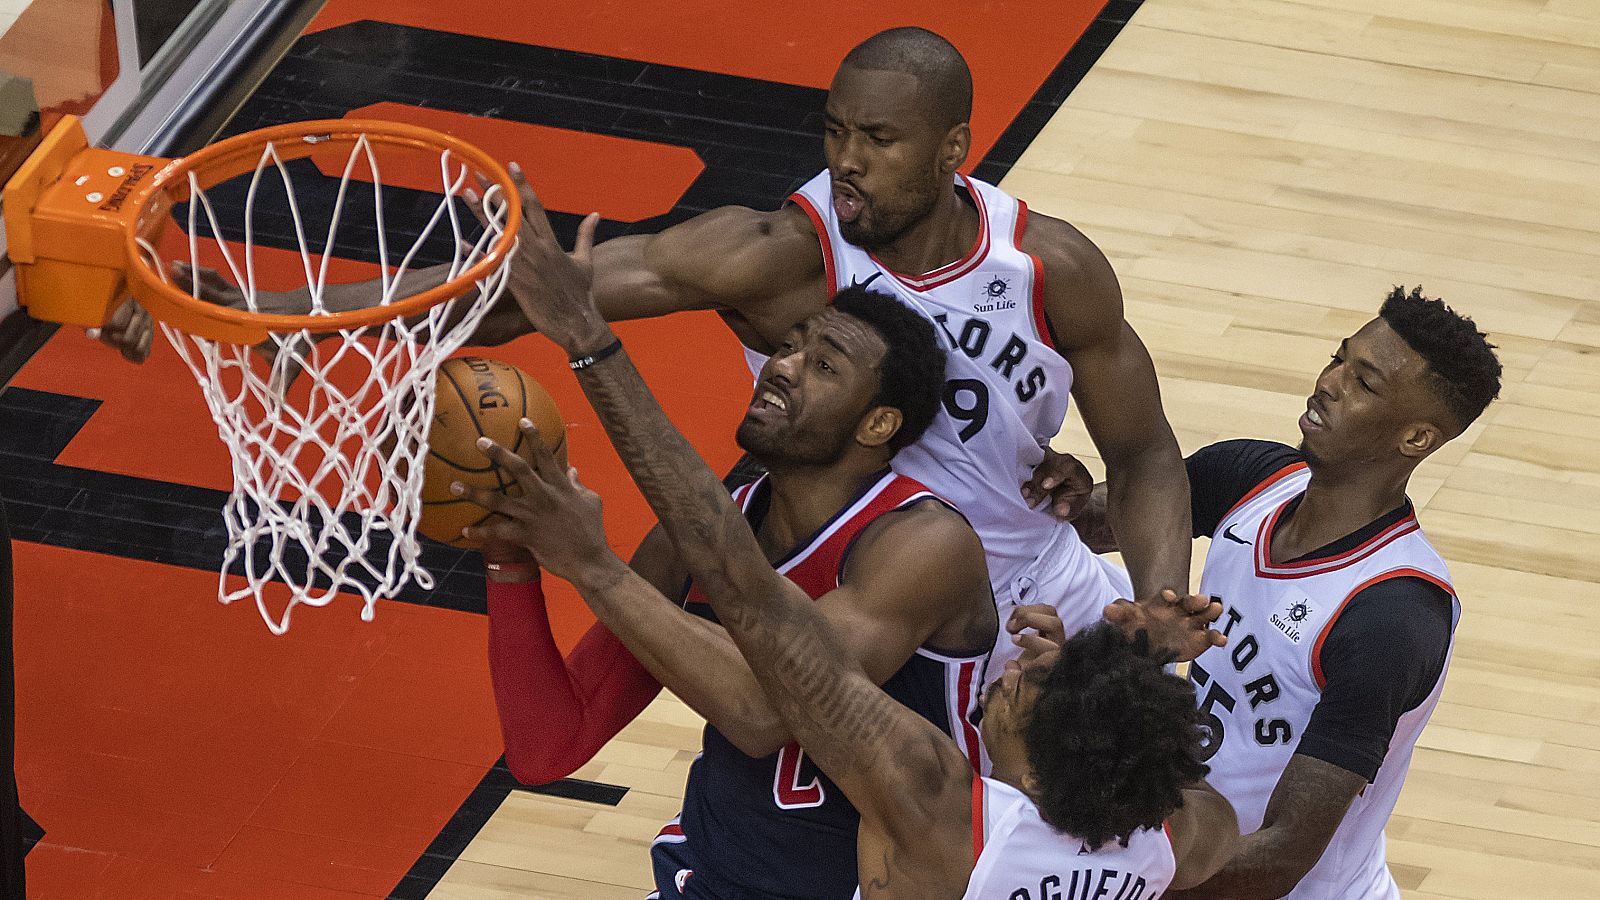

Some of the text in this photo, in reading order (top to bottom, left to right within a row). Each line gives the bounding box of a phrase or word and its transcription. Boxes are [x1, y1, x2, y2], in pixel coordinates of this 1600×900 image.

[98, 163, 154, 212] SPALDING
[973, 300, 1016, 313] Sun Life
[1269, 613, 1301, 643] Sun Life
